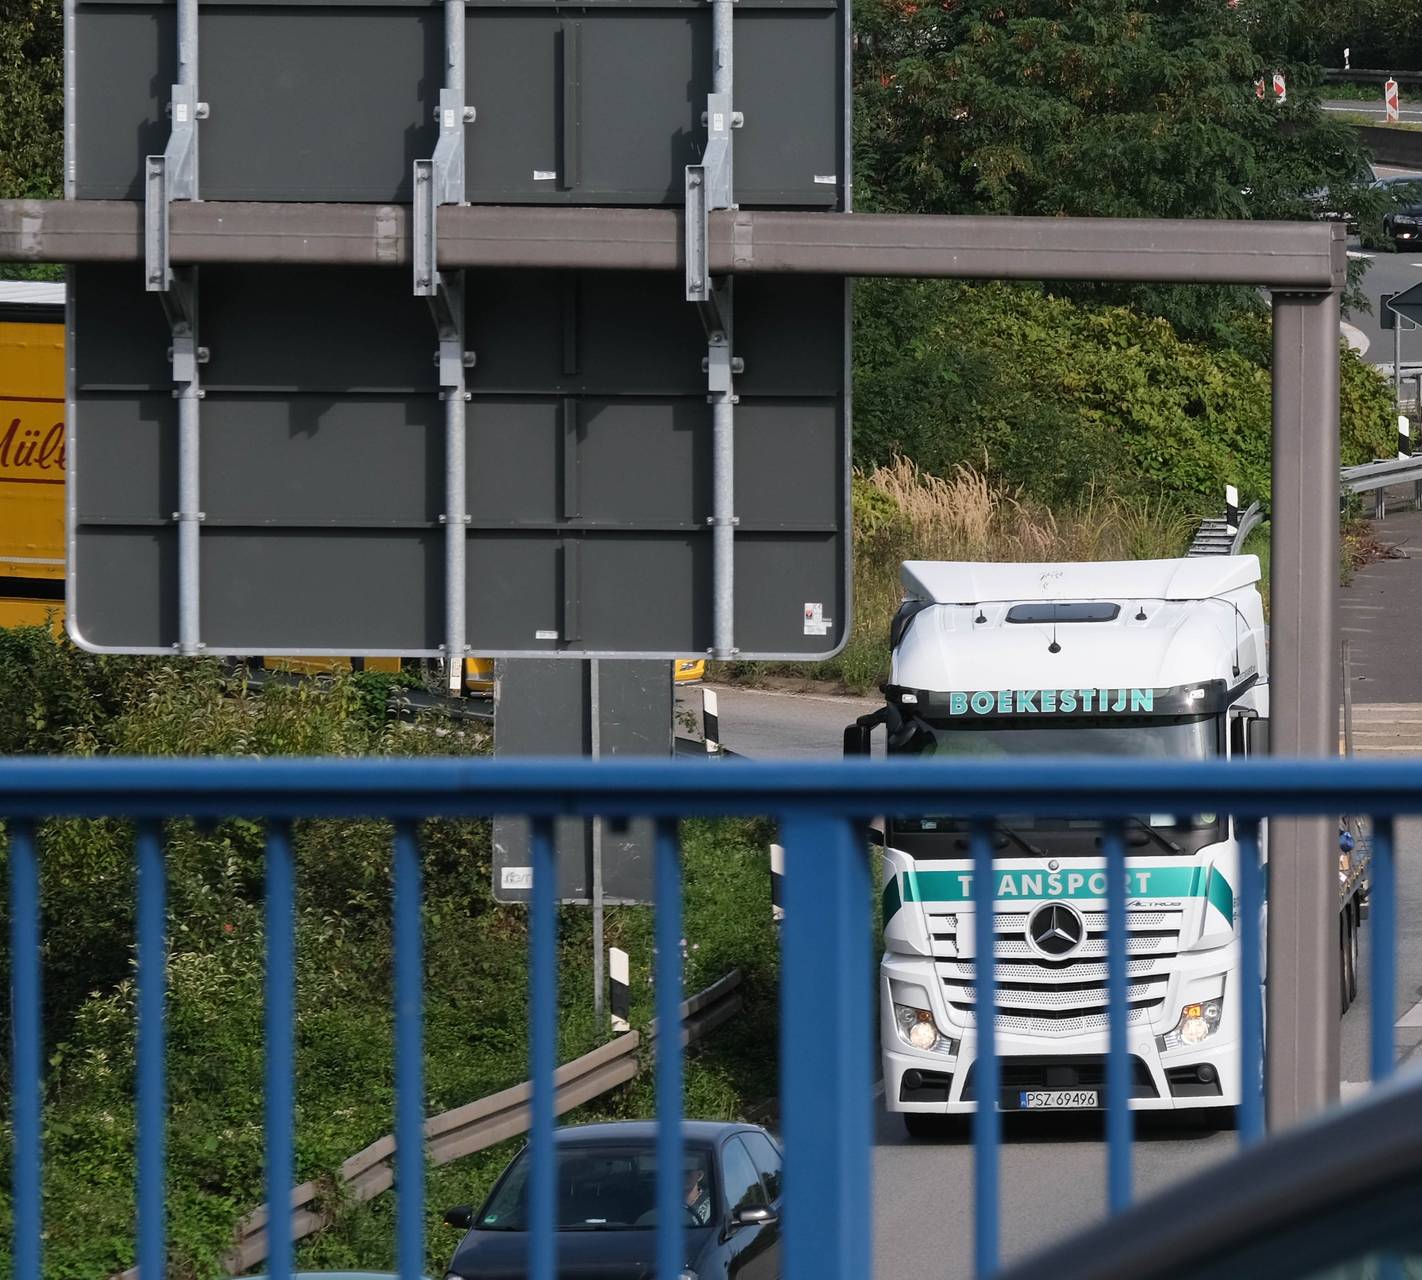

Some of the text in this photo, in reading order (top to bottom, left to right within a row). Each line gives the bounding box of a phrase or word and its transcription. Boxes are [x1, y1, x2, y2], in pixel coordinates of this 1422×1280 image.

[950, 688, 1153, 715] BOEKESTIJN
[958, 872, 1151, 897] TANSPOT
[1027, 1092, 1095, 1106] PSZ 69496
